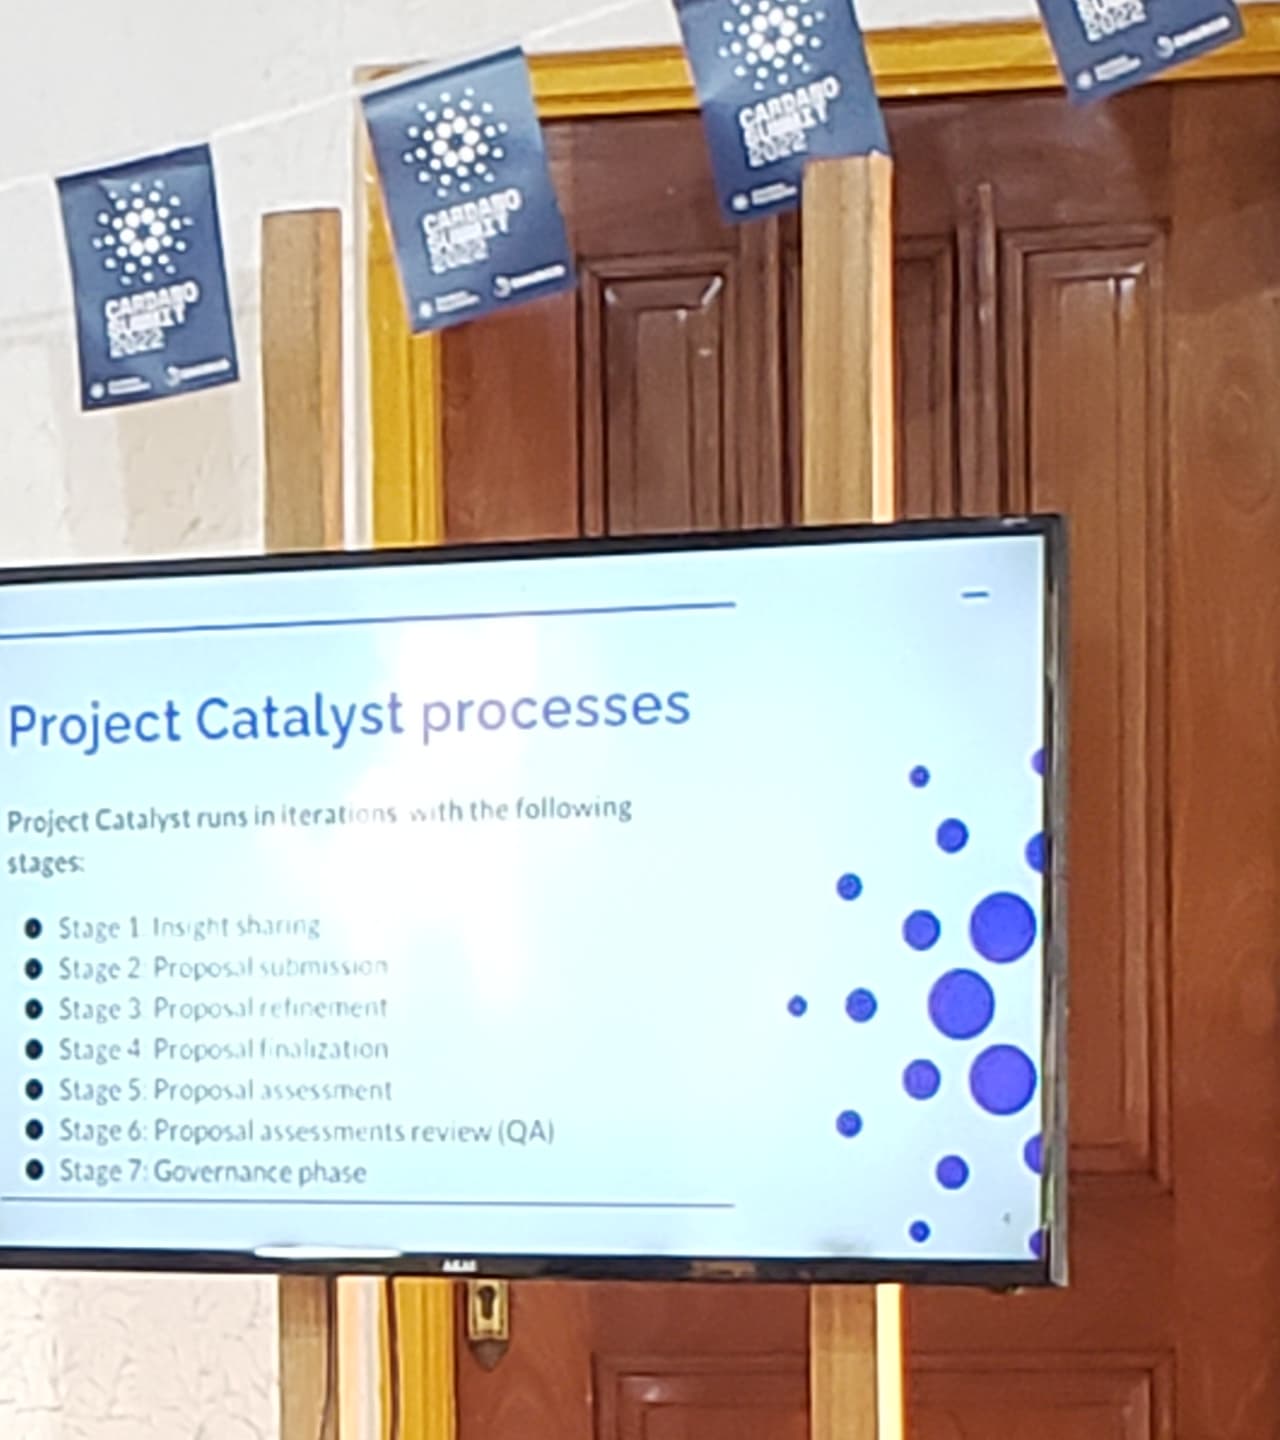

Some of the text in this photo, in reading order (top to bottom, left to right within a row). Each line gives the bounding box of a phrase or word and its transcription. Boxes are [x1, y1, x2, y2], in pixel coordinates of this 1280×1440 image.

[10, 690, 691, 757] Project Catalyst processes
[7, 808, 90, 839] Project
[94, 806, 191, 834] Catalyst
[196, 810, 249, 829] runs
[254, 805, 276, 827] in
[469, 799, 510, 823] the
[515, 795, 633, 824] following
[6, 852, 85, 880] stages:
[58, 915, 121, 945] Stage
[152, 916, 230, 943] Insight
[235, 913, 321, 942] sharing
[58, 955, 122, 985] Stage
[153, 954, 254, 983] Proposal
[258, 957, 389, 978] submission
[58, 995, 122, 1025] Stage
[153, 995, 254, 1024] Proposal
[258, 996, 388, 1020] refinement
[58, 1036, 122, 1067] Stage
[153, 1036, 254, 1064] Proposal
[259, 1036, 389, 1061] finalization
[58, 1076, 123, 1107] Stage
[153, 1076, 254, 1105] Proposal
[260, 1081, 393, 1102] assessment
[58, 1116, 123, 1147] Stage
[153, 1116, 254, 1147] Proposal
[259, 1122, 406, 1143] assessments
[410, 1124, 493, 1143] review
[497, 1118, 555, 1147] (QA)
[59, 1157, 123, 1188] Stage
[152, 1157, 293, 1185] Governance
[297, 1159, 368, 1189] phase
